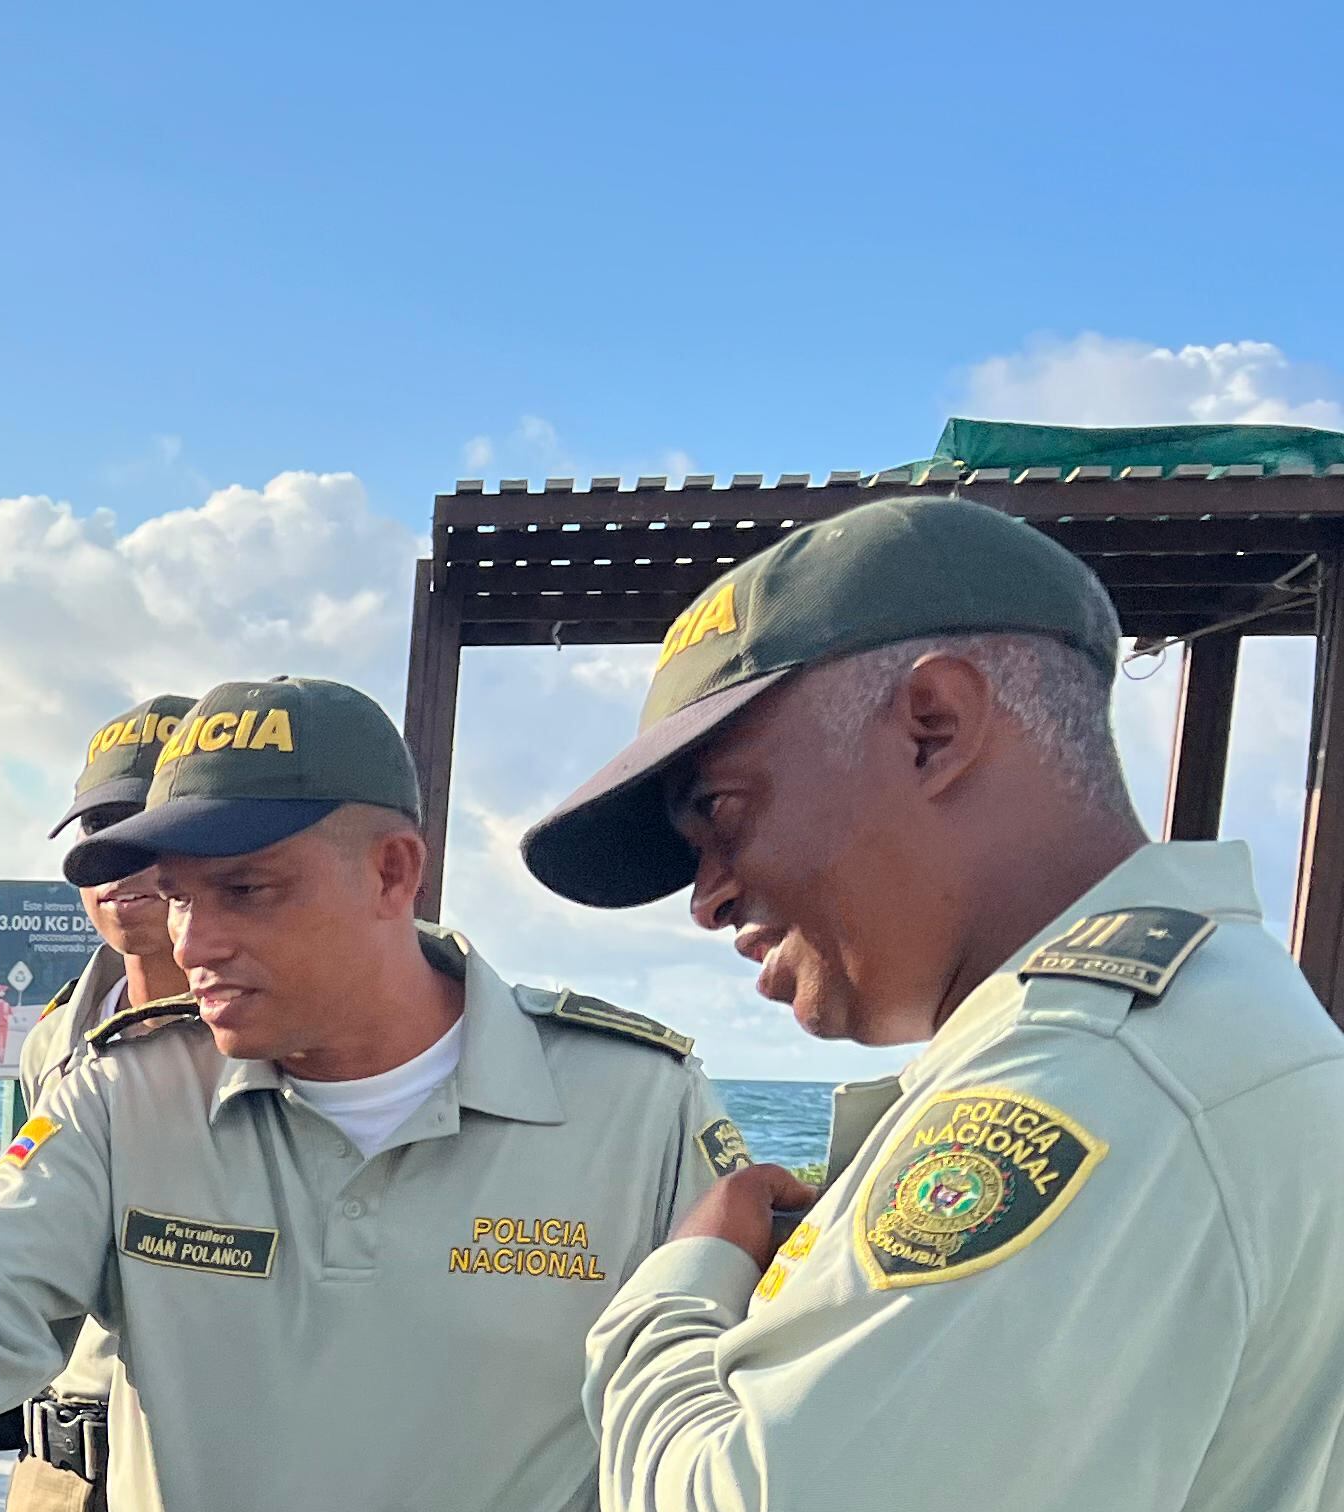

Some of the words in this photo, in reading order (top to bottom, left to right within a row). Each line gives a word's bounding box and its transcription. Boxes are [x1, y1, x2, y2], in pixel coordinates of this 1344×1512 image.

[154, 708, 295, 776] LICIA
[23, 901, 42, 912] Este
[44, 916, 69, 931] KG
[951, 1101, 1061, 1154] POLICIA
[912, 1122, 1060, 1196] NACIONAL
[165, 1223, 235, 1245] Patrullero
[471, 1217, 590, 1250] POLICIA
[867, 1227, 947, 1269] COLOMBIA
[137, 1235, 177, 1258] JUAN
[180, 1243, 253, 1268] POLANCO
[448, 1247, 606, 1281] NACIONAL
